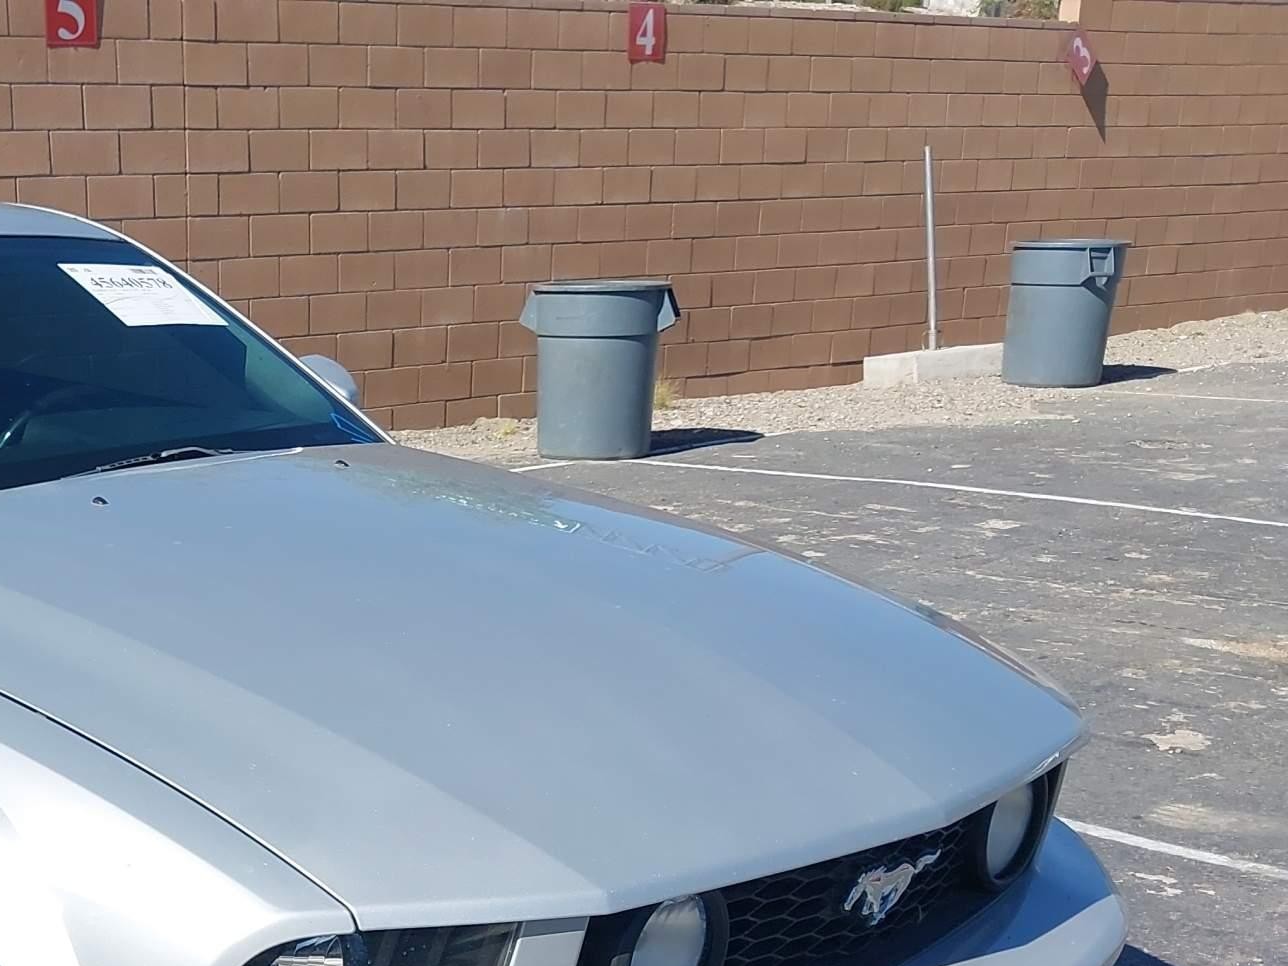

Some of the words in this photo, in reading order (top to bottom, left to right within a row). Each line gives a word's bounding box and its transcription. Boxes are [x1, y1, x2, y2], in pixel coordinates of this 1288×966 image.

[57, 0, 85, 40] 5
[635, 8, 656, 56] 4
[1073, 37, 1091, 74] 3
[90, 276, 174, 289] 45640578
